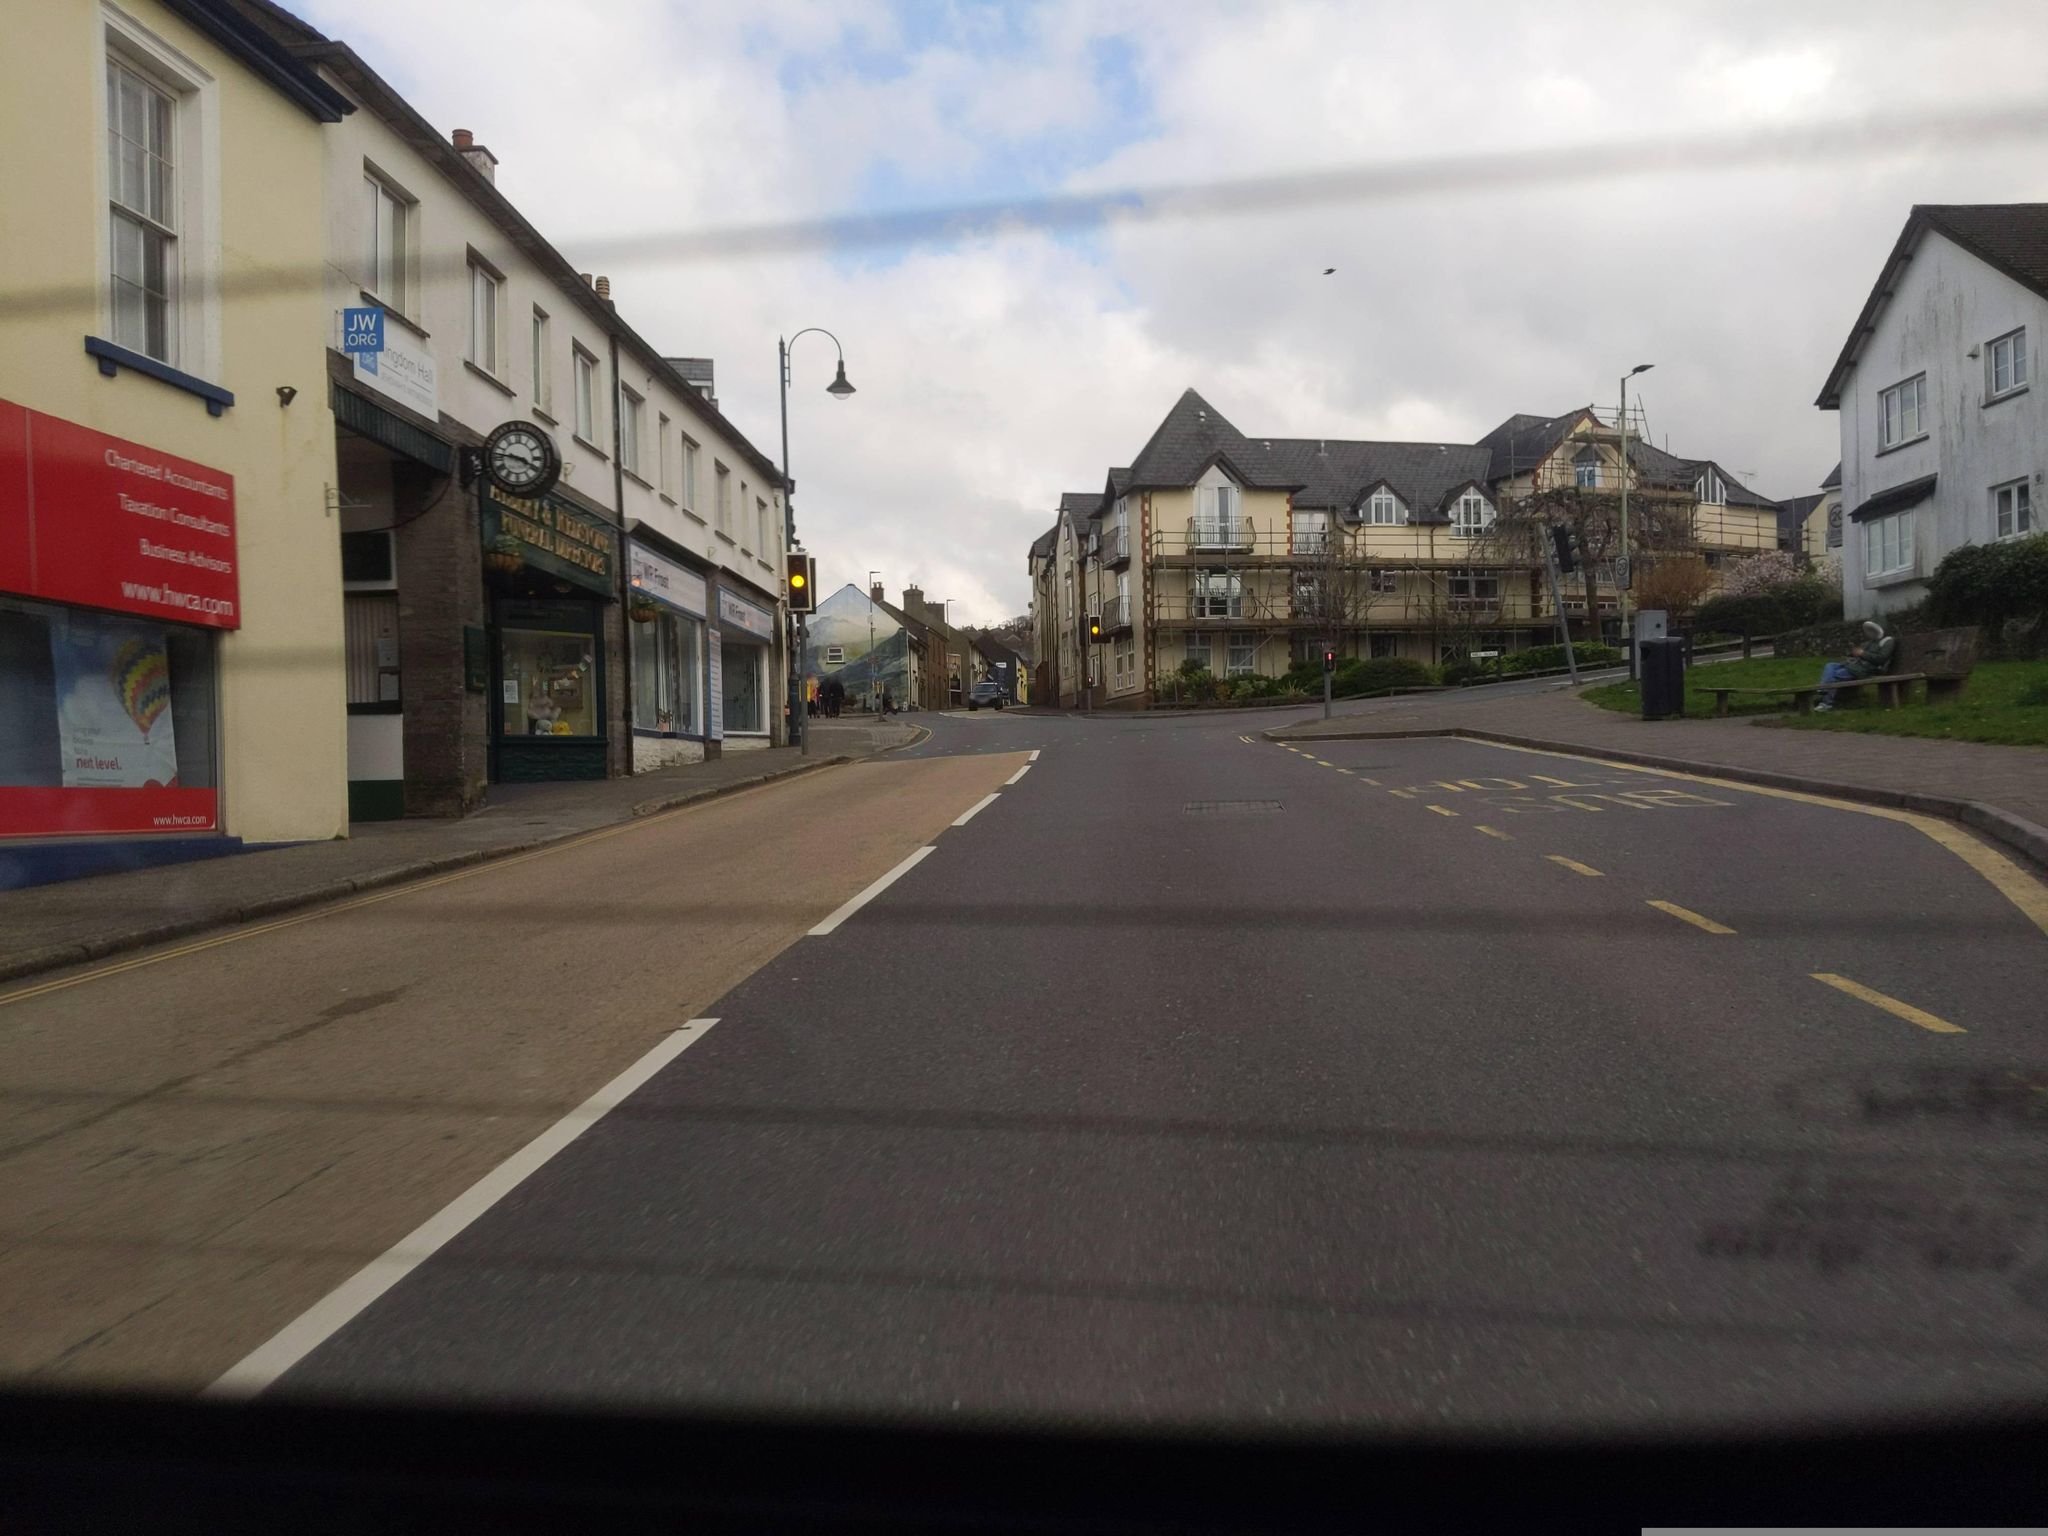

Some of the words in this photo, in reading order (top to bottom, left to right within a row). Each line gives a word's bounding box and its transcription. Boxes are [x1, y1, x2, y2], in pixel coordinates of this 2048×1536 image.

[348, 313, 376, 332] JW
[346, 333, 377, 346] .ORG
[104, 448, 162, 481] Chartered
[163, 467, 230, 500] Accountants
[118, 493, 169, 522] Taxation
[170, 507, 231, 537] Consultants
[139, 537, 187, 564] Business
[188, 554, 232, 574] Advisors
[121, 581, 234, 617] www.hwca.com
[95, 756, 122, 771] level.
[1474, 789, 1737, 813] BUS
[152, 814, 207, 826] www.hwca.com
